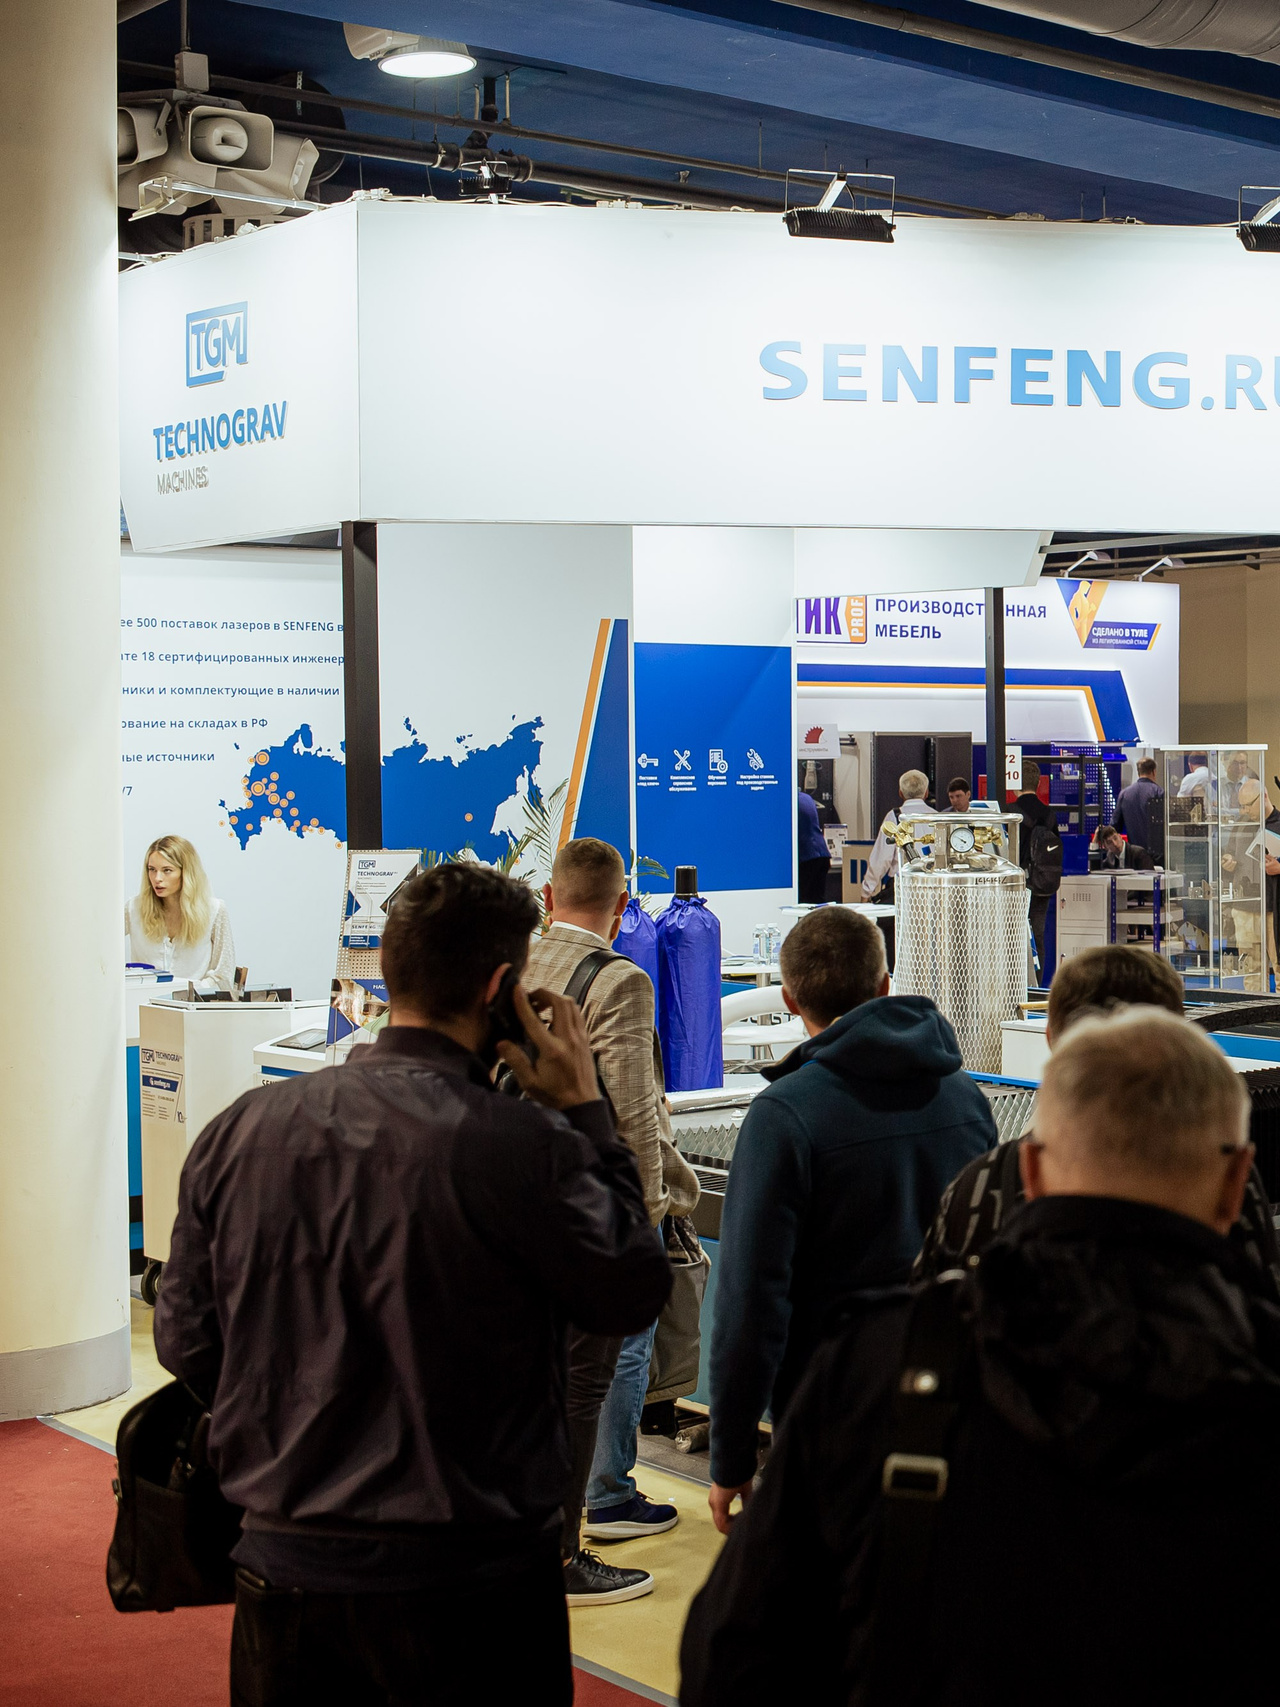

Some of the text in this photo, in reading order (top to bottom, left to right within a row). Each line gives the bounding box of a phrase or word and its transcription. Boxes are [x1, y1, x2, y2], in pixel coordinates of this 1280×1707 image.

[190, 312, 248, 372] TGM
[153, 400, 289, 462] TECHNOGRAV
[157, 465, 209, 495] MACHINES
[875, 598, 1047, 618] ПРОИЗВОДСТННАЯ
[796, 597, 842, 635] ИК
[850, 596, 864, 637] PROF
[137, 617, 158, 628] 500
[160, 619, 218, 629] поставок
[221, 620, 271, 632] лазеров
[273, 622, 280, 631] в
[283, 621, 334, 632] SENFENG
[875, 624, 942, 639] МЕБЕЛЬ
[1092, 627, 1148, 638] СДЕЛАНО В ТУЛЕ
[141, 651, 155, 661] 18
[158, 652, 289, 665] сертифицированных
[292, 655, 345, 666] инженер
[122, 687, 155, 695] ники
[158, 687, 167, 695] и
[170, 687, 274, 698] комплектующие
[287, 687, 340, 695] наличии
[170, 720, 184, 728] на
[188, 720, 238, 730] складах
[241, 719, 248, 728] в
[251, 718, 268, 728] РФ
[146, 753, 215, 762] источники
